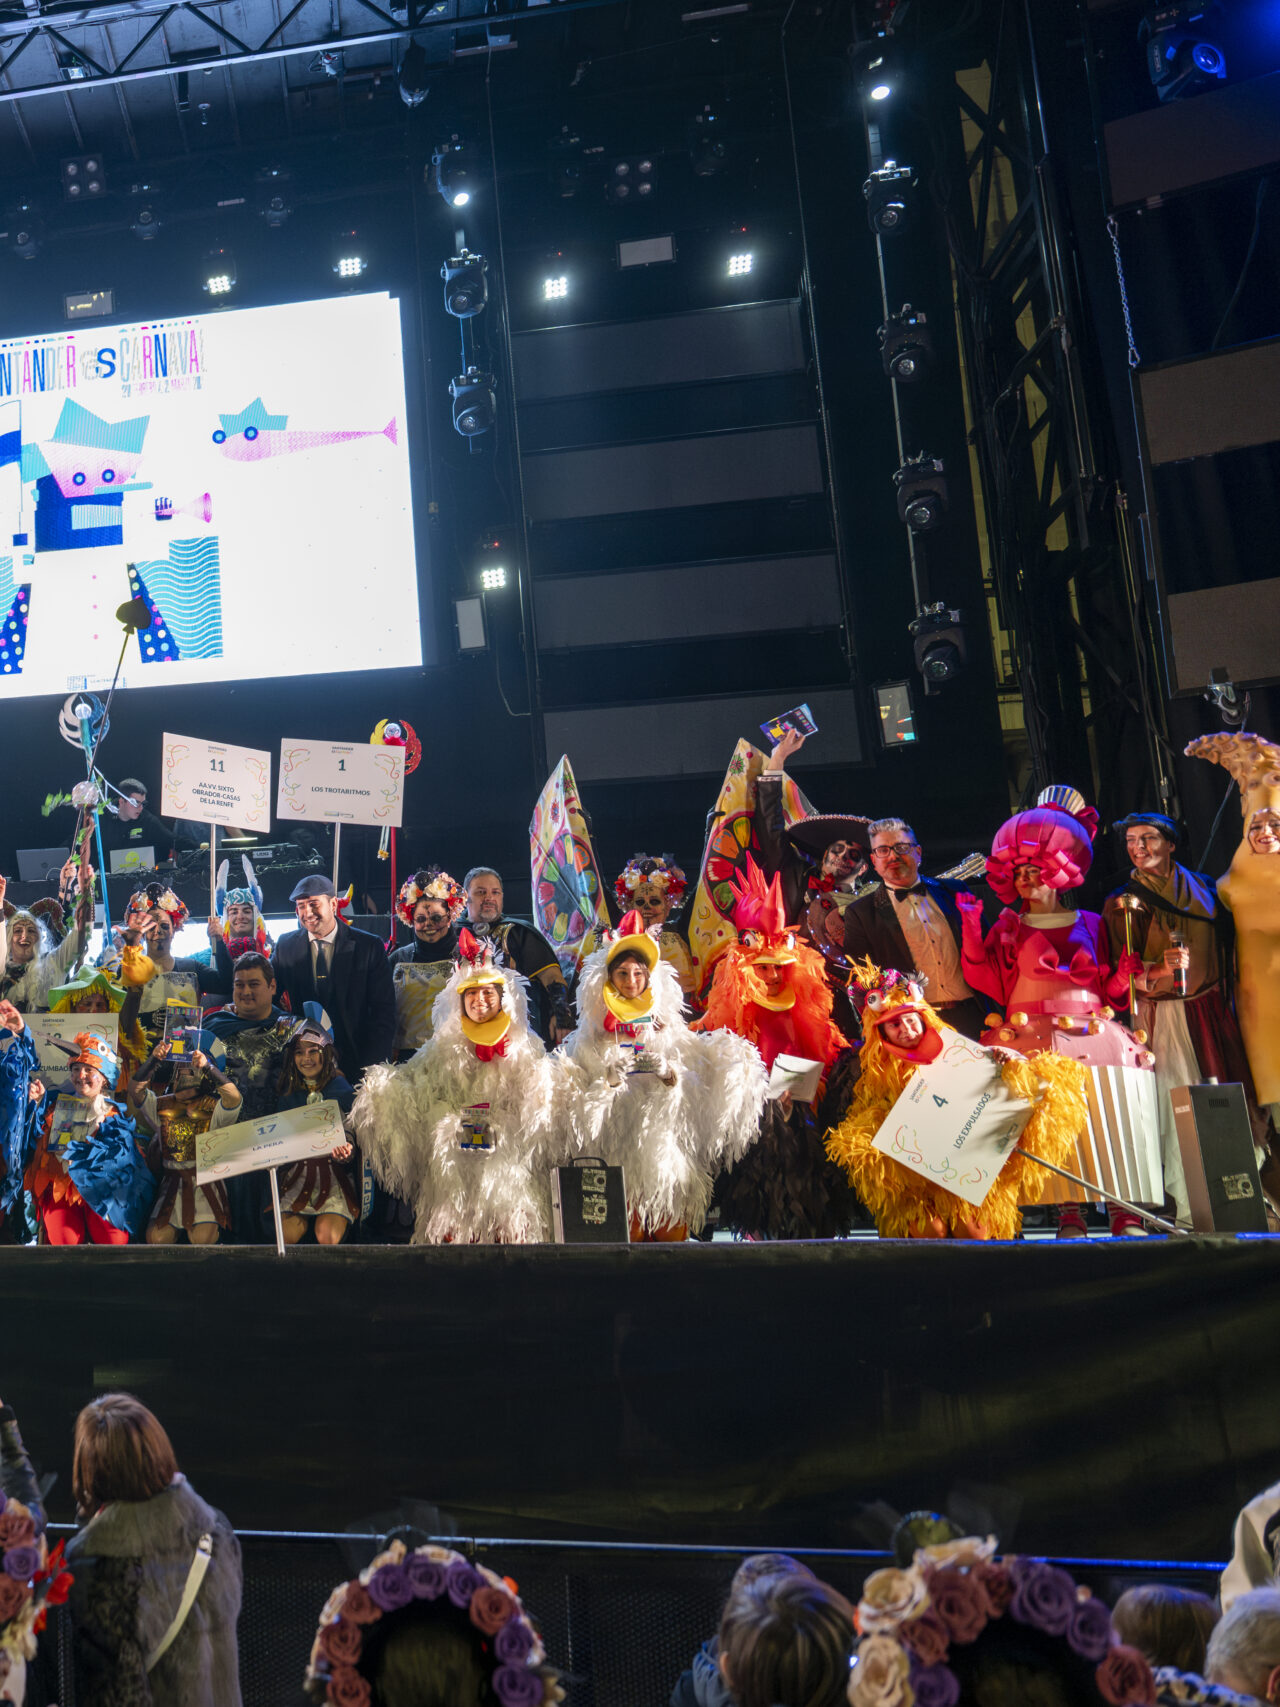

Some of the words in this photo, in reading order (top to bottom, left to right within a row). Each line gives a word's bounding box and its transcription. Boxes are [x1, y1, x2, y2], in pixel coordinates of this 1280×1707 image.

[210, 759, 225, 773] 11
[338, 759, 346, 771] 1
[218, 785, 235, 793] SIXTO
[216, 800, 234, 808] RENFE
[932, 1094, 949, 1108] 4
[953, 1133, 966, 1150] LOS
[961, 1091, 992, 1137] EXPULSADOS
[256, 1124, 277, 1136] 17
